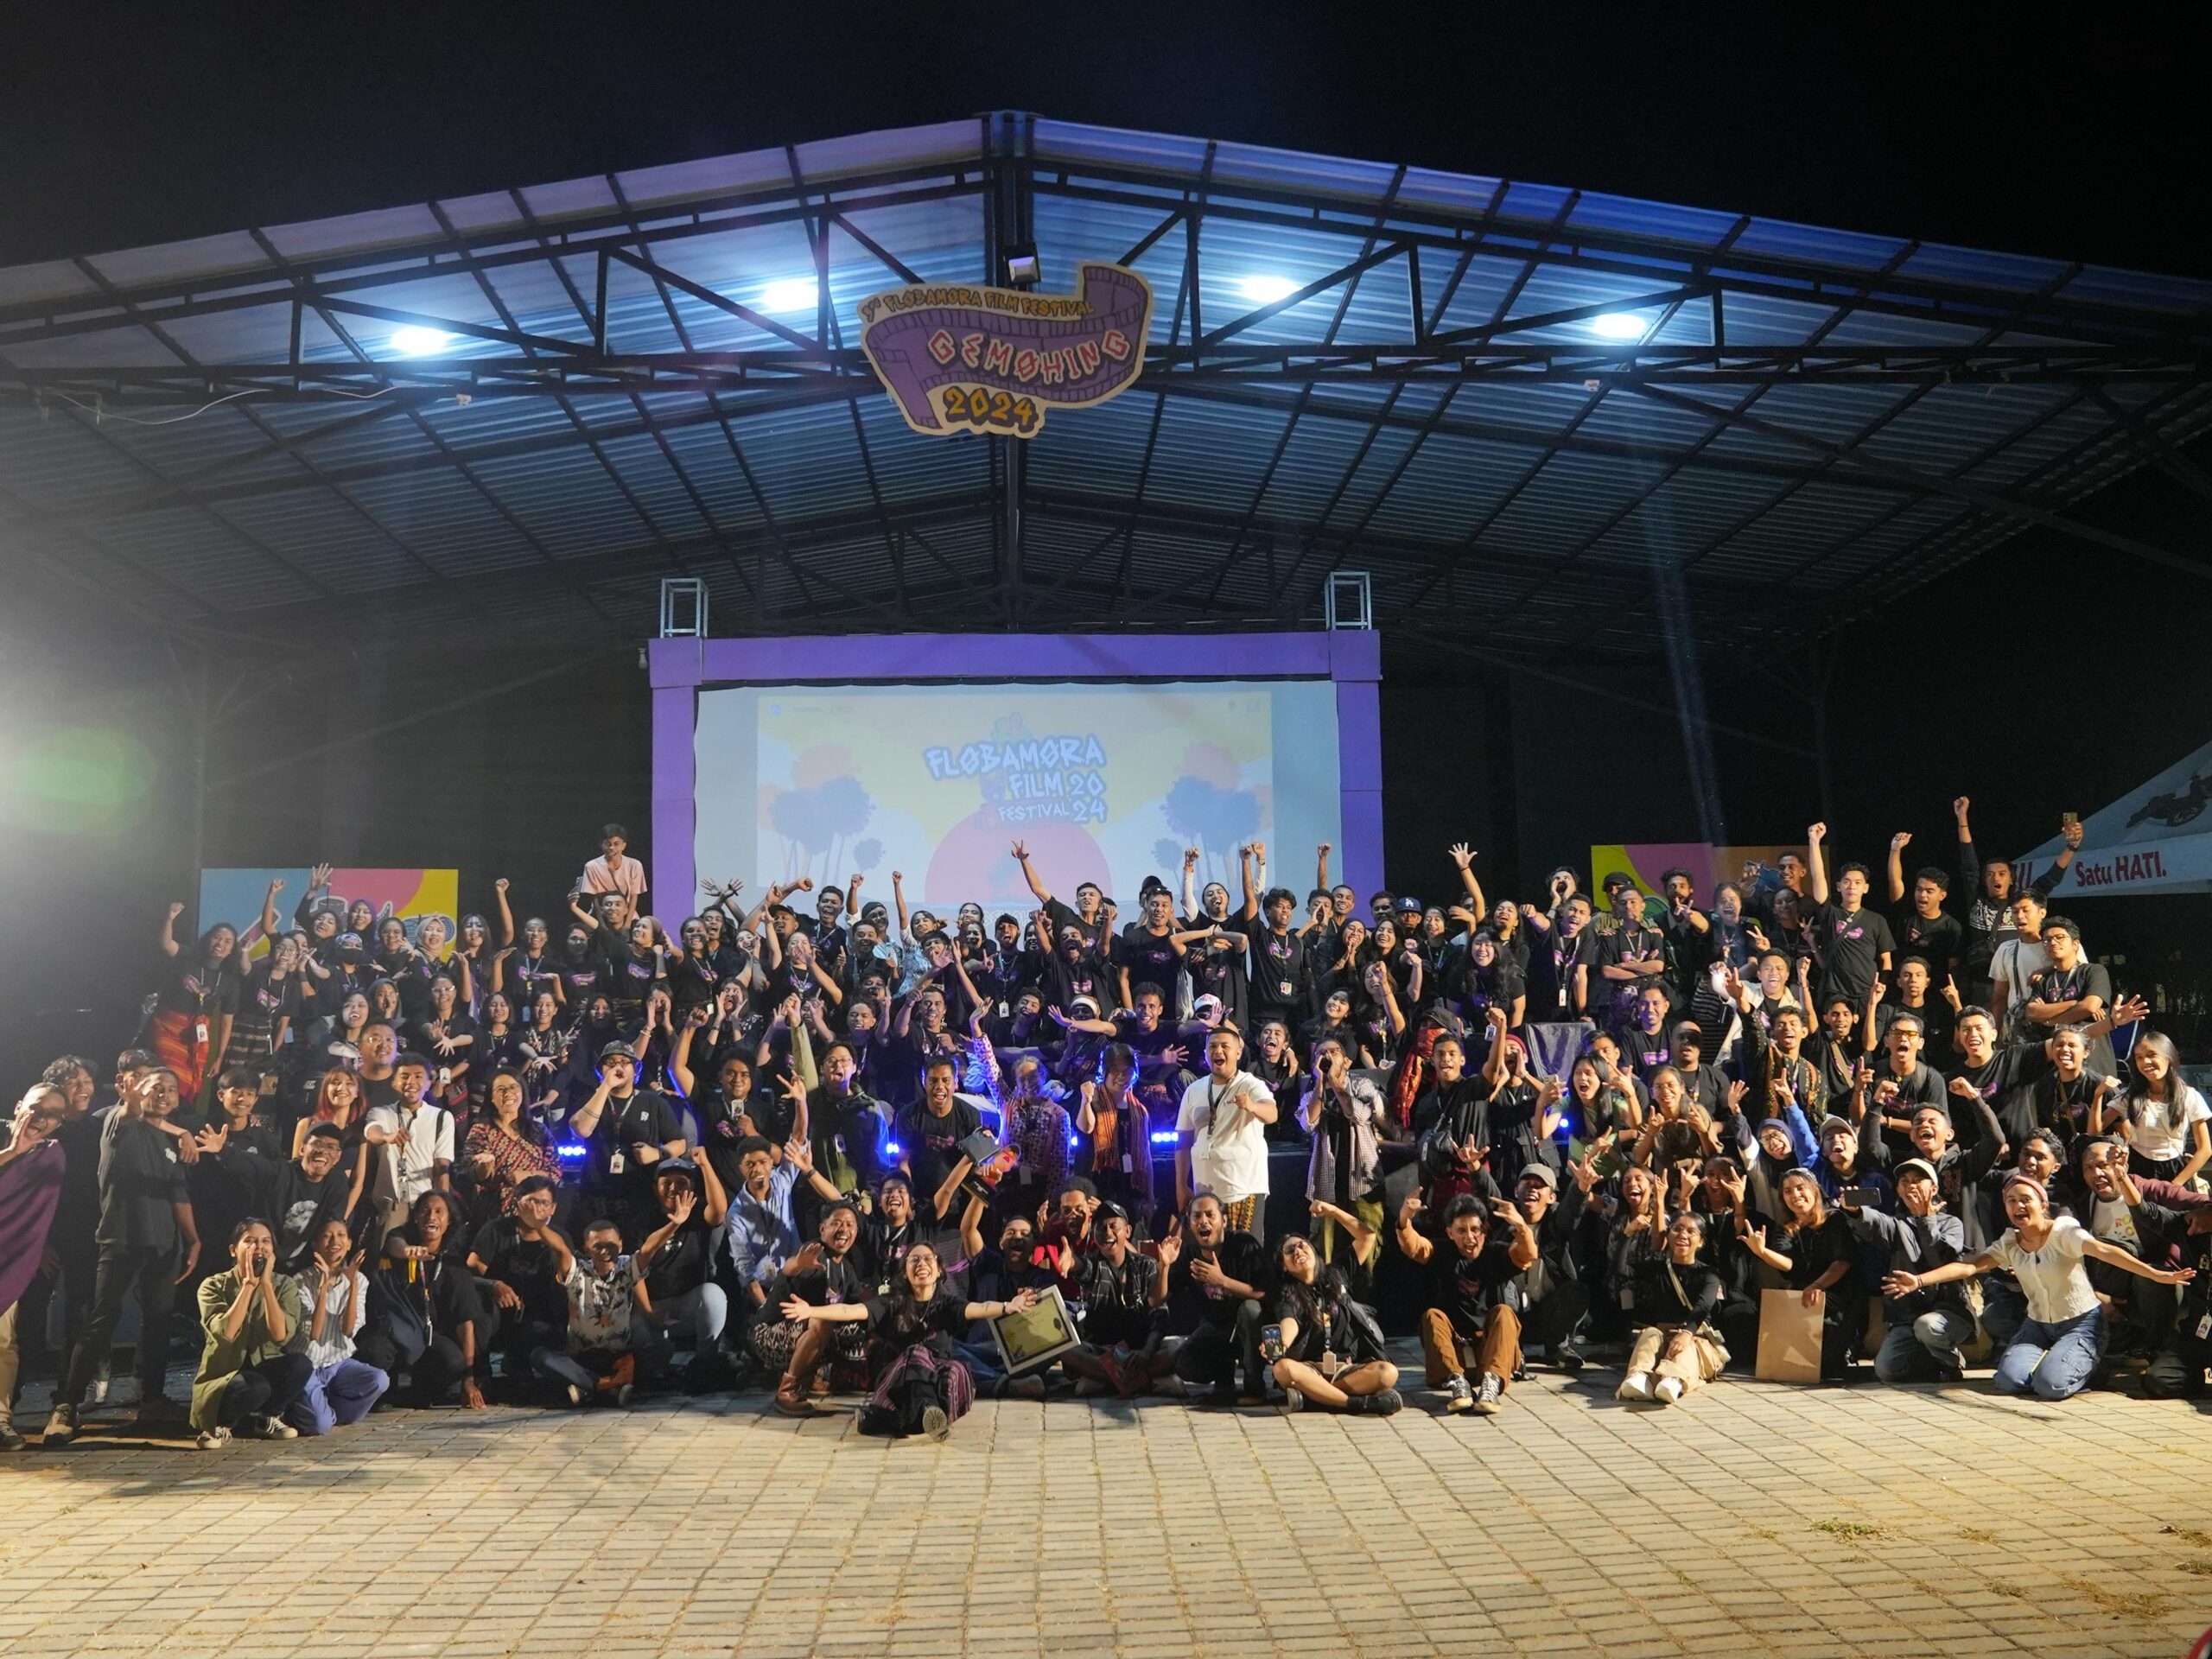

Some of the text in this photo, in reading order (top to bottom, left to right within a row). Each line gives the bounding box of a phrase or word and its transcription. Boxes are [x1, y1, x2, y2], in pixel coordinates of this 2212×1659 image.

[984, 290, 1020, 313] FILM
[944, 386, 1035, 429] 2024
[1008, 771, 1104, 799] FILM 20
[997, 798, 1106, 823] FESTIVAL 24
[2075, 861, 2113, 887] Satu
